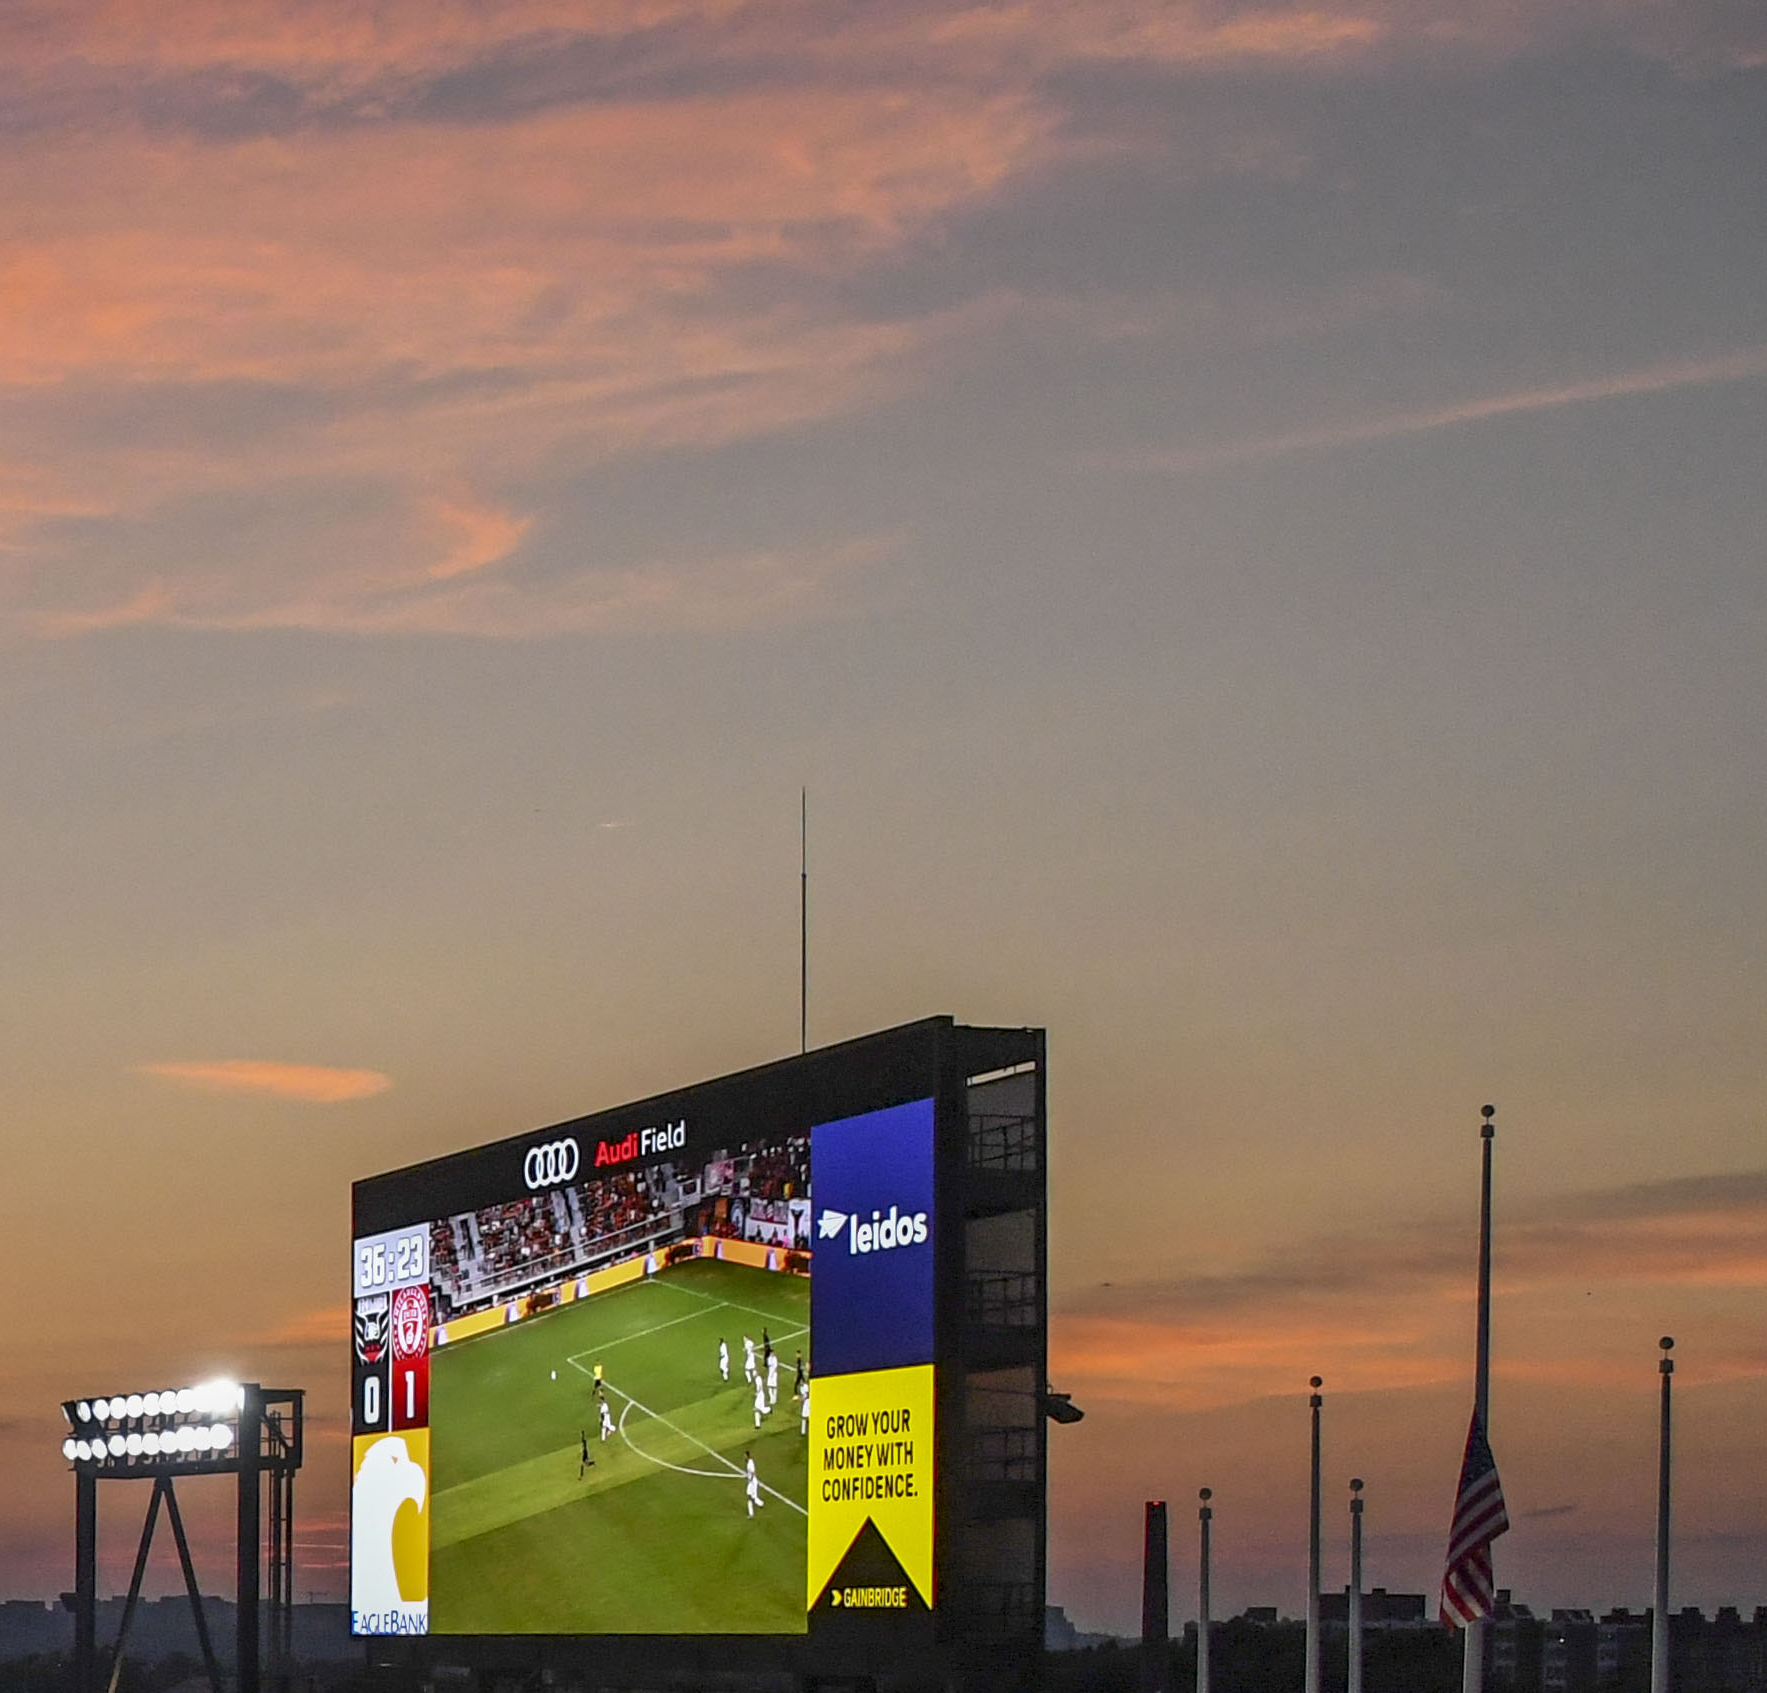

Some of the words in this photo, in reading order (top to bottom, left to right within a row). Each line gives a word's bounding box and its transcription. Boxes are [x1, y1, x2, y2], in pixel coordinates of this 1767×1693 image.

[594, 1132, 640, 1167] Audi
[640, 1119, 686, 1156] Field
[849, 1204, 928, 1255] leidos
[360, 1235, 425, 1289] 36:23
[363, 1376, 381, 1424] 0
[404, 1370, 416, 1419] 1
[826, 1412, 869, 1440] GROW
[871, 1408, 912, 1435] YOUR
[823, 1444, 875, 1472] MONEY
[876, 1440, 914, 1467] WITH
[822, 1472, 919, 1502] CONFIDENCE.
[842, 1587, 908, 1608] GAINBRIDGE
